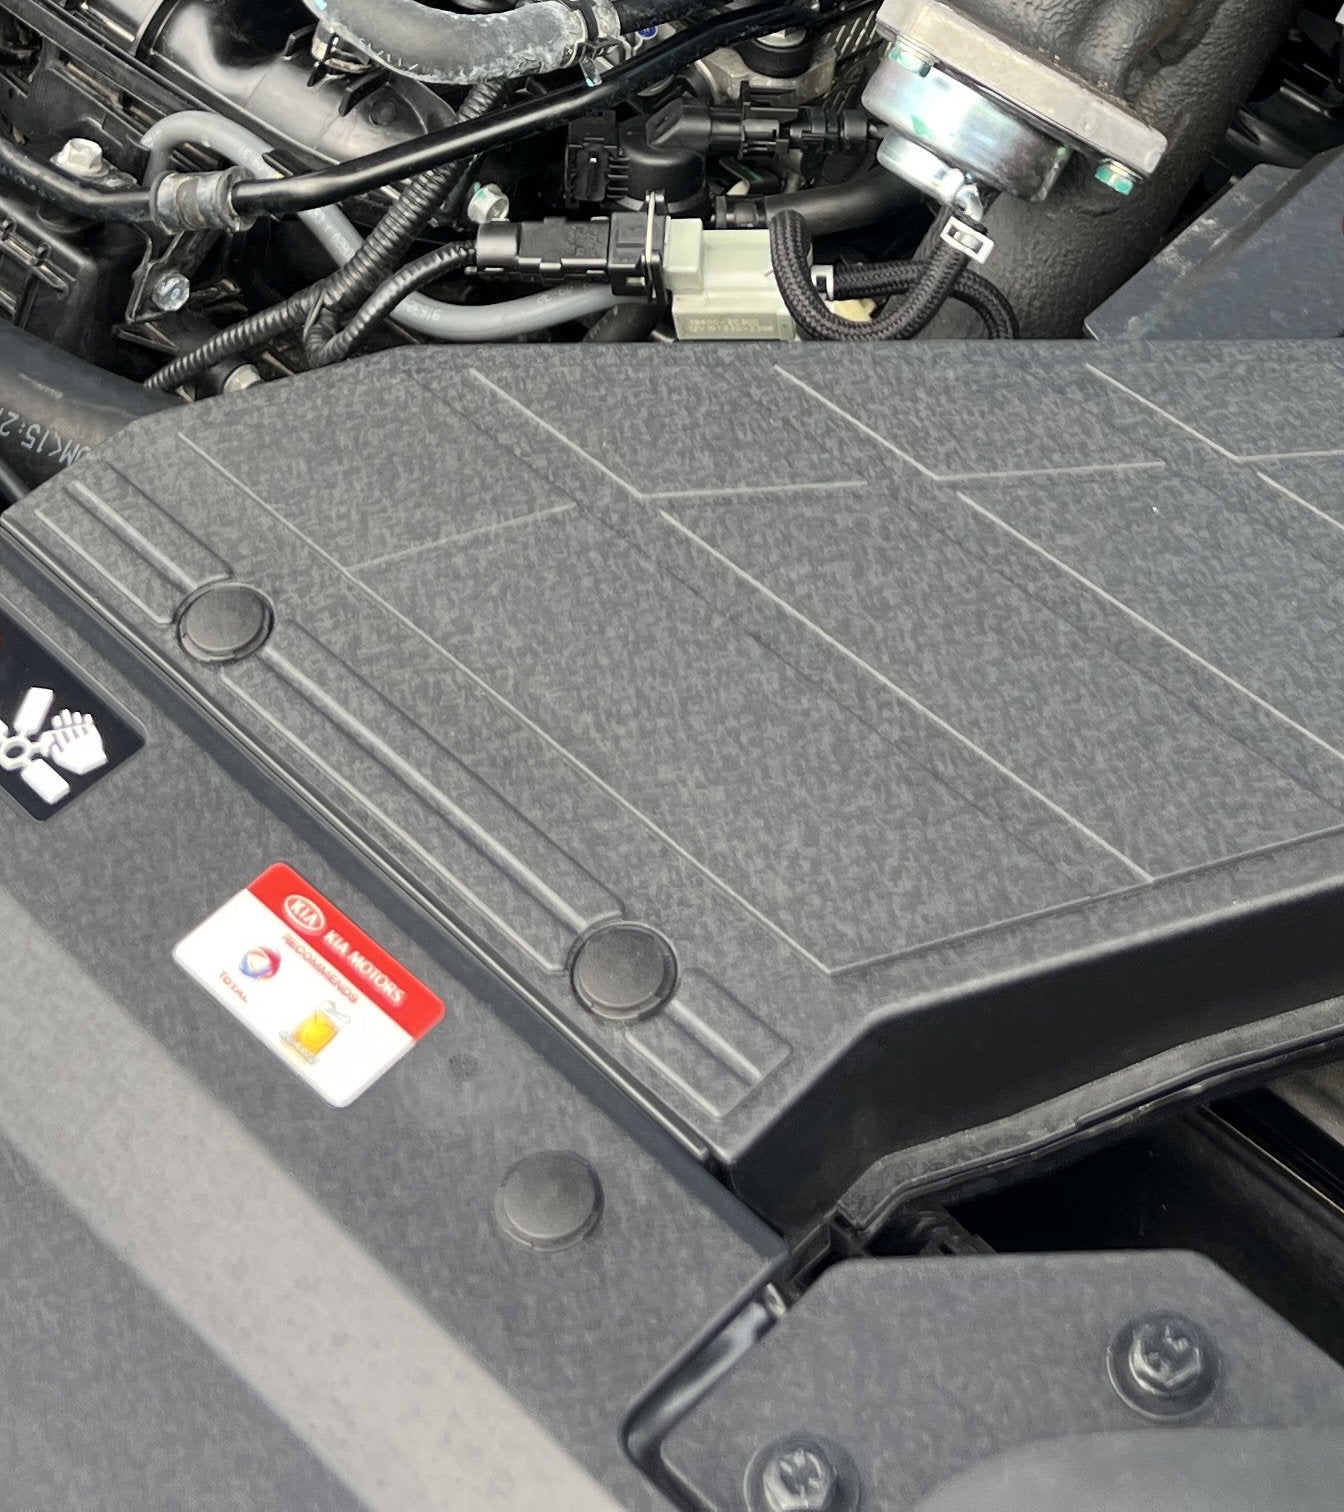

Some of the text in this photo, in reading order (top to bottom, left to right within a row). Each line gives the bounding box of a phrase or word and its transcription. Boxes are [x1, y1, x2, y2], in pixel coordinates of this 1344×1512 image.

[216, 969, 251, 1005] TOTAL
[280, 931, 362, 1005] RECOMMENDS
[321, 929, 407, 1004] KIA MOTORS
